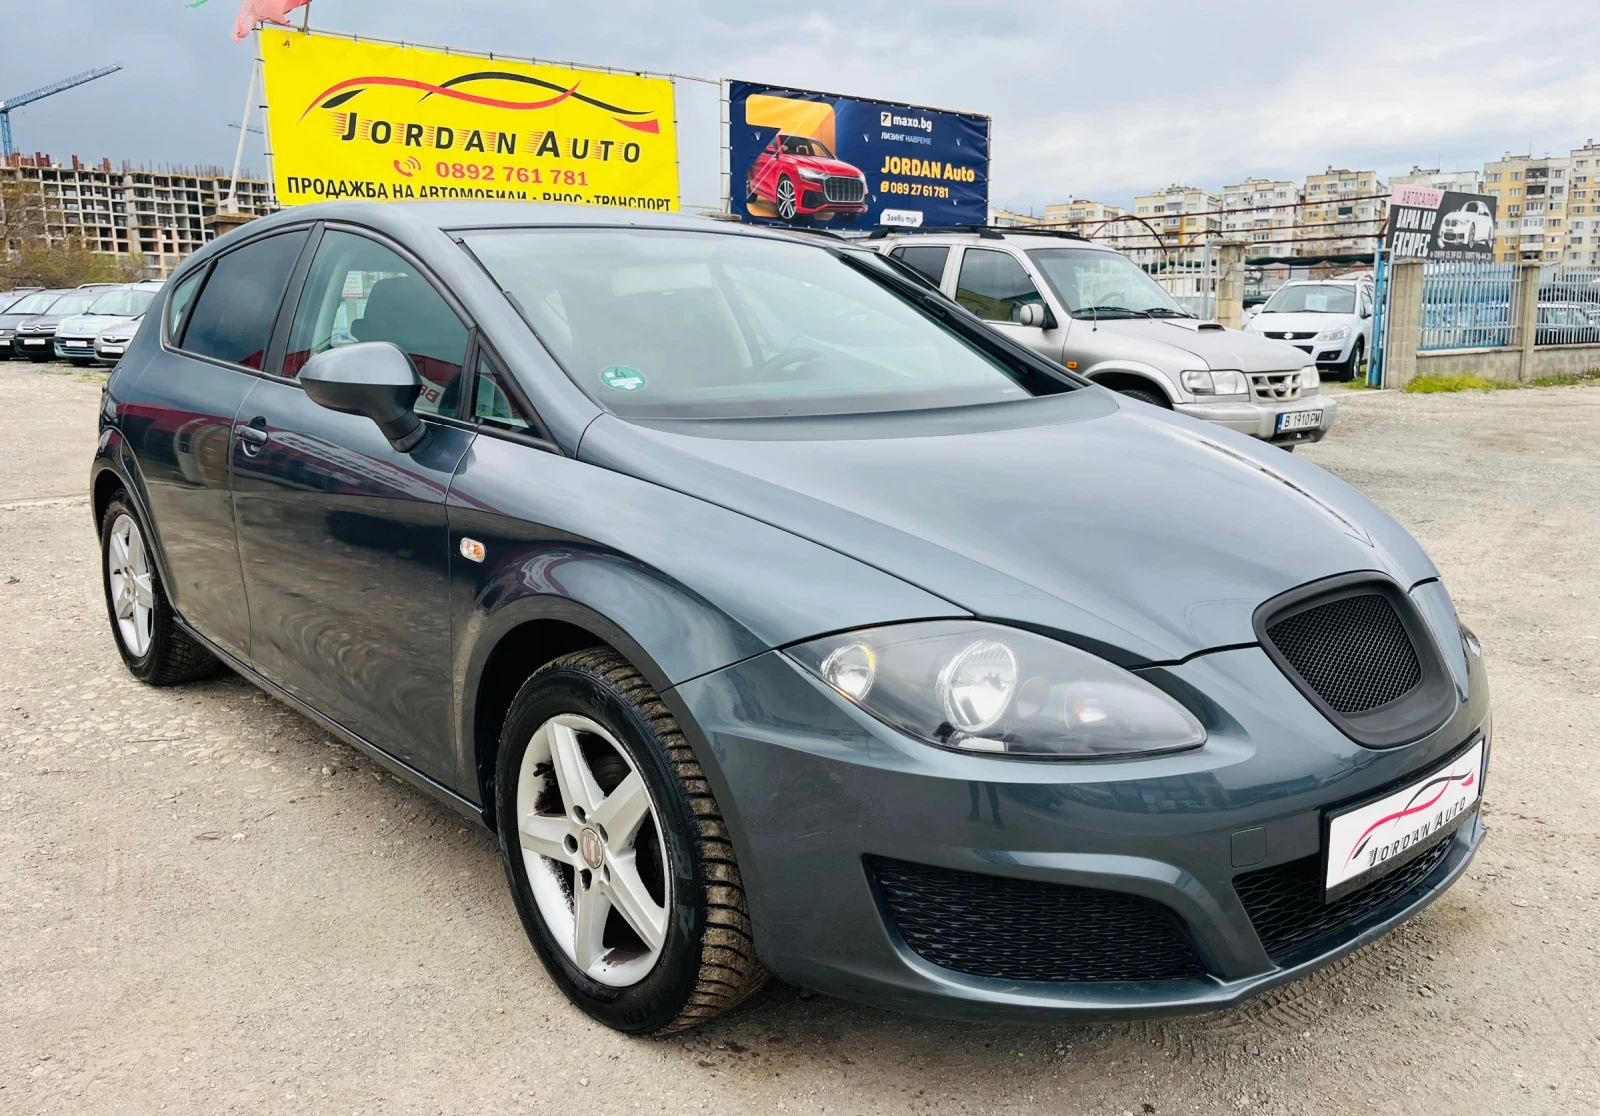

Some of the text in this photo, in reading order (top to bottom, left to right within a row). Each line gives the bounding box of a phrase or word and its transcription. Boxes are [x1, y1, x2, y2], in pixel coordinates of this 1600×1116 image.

[892, 115, 933, 133] maxo.bg
[880, 131, 932, 146] ЛИЗИНГ НАВРЕМЕ
[435, 161, 589, 187] 0892 761 781
[880, 155, 975, 183] JORDAN Auto
[287, 176, 389, 199] ПРОДАЖБА
[392, 183, 415, 199] НА
[890, 181, 949, 199] 089 27 61 781
[1401, 190, 1438, 207] АВТОСАЛОН
[1391, 231, 1432, 258] ЕКСПРЕС
[1284, 415, 1291, 428] B
[1368, 796, 1467, 867] JORDAN AUTO
